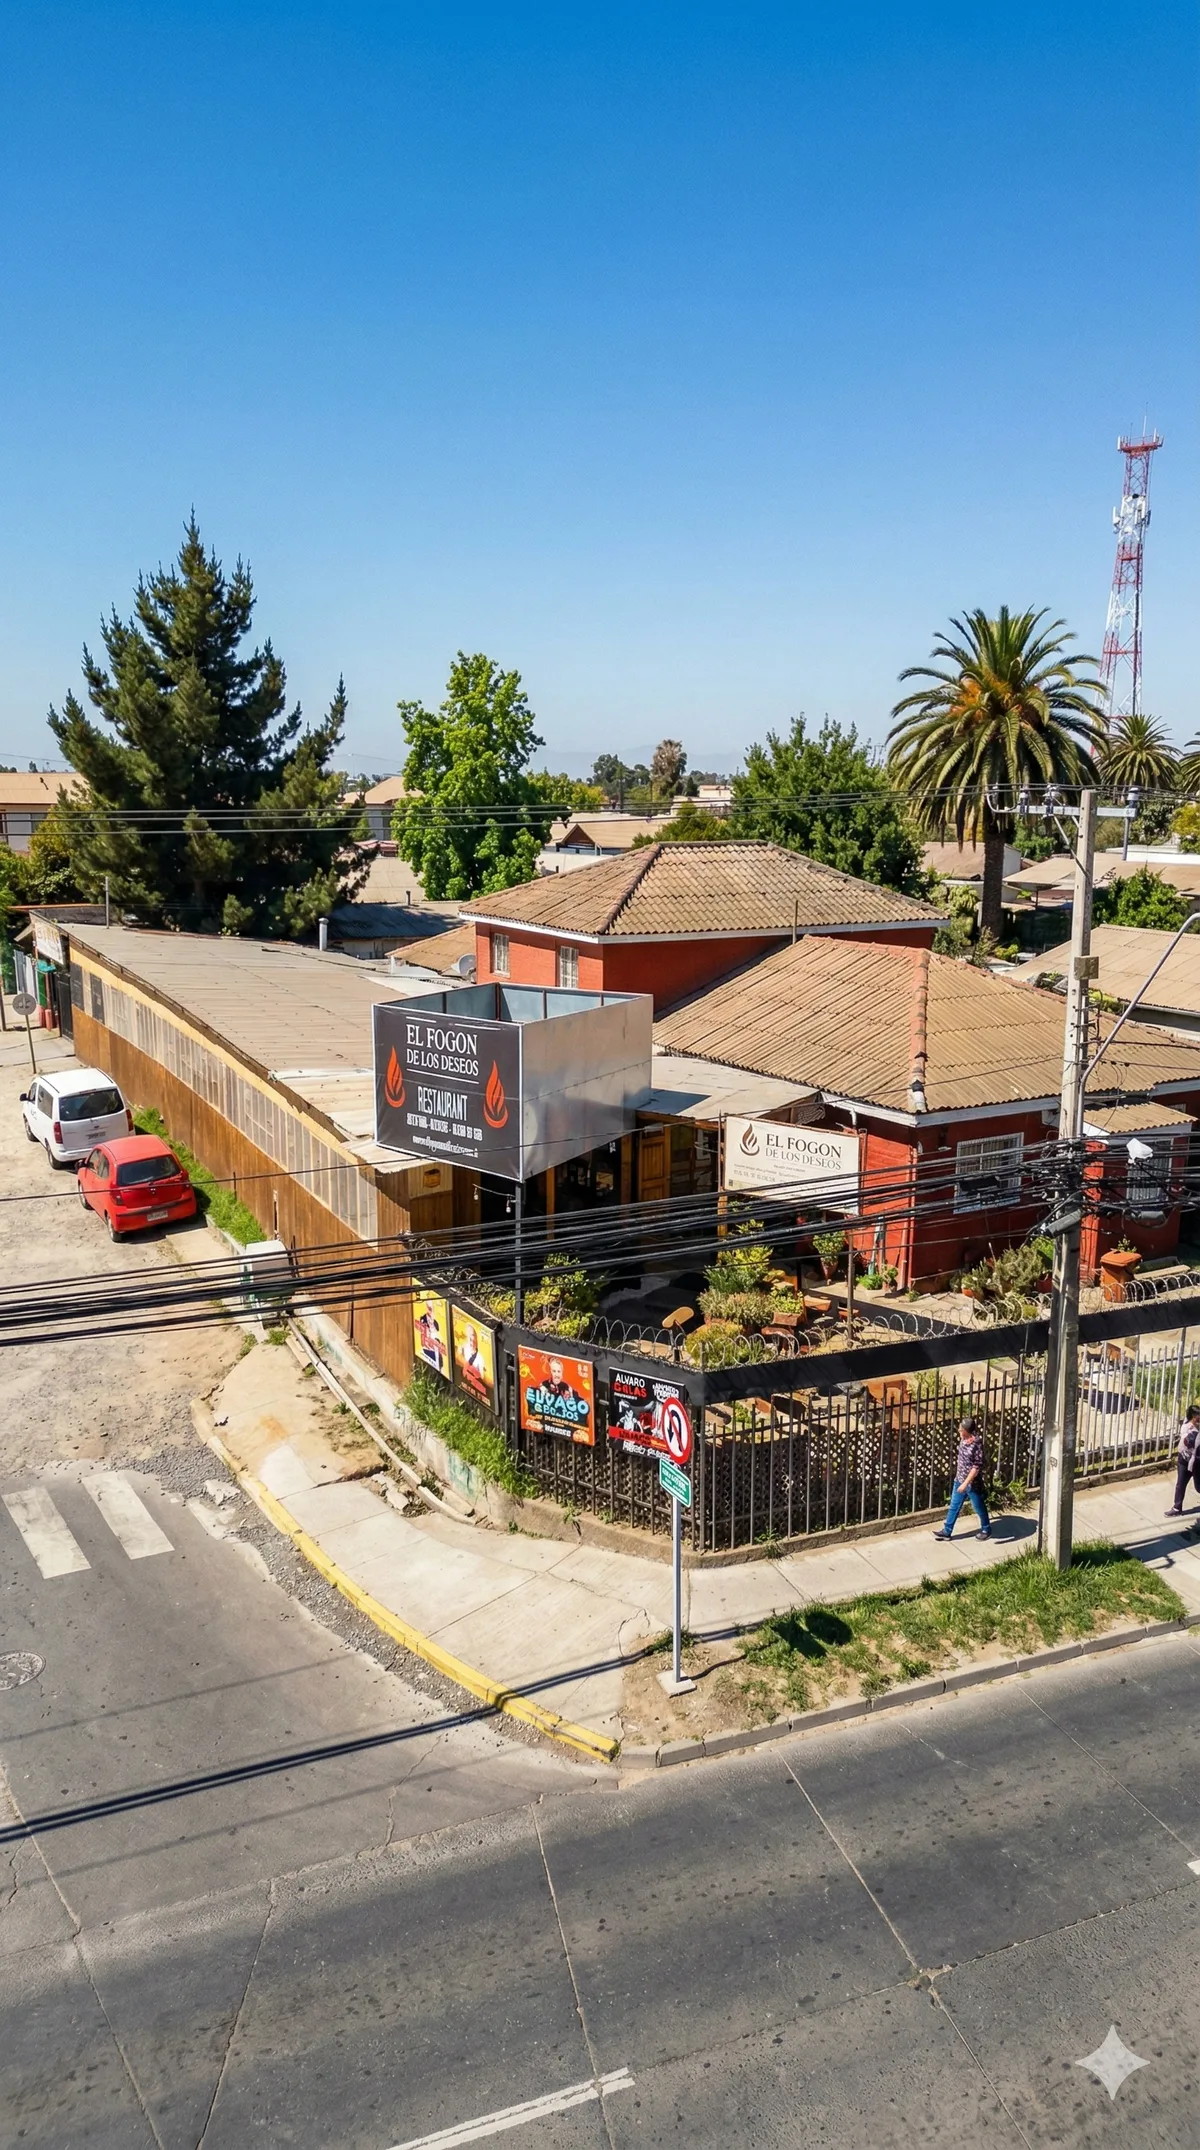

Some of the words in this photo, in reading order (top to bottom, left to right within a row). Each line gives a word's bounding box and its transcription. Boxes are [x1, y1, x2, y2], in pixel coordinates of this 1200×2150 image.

[406, 1024, 423, 1046] EL
[426, 1027, 478, 1055] FOGON
[406, 1049, 420, 1065] DE
[421, 1051, 439, 1069] LOS
[441, 1055, 479, 1076] DESEOS
[417, 1086, 468, 1121] RESTAURANT
[765, 1147, 779, 1158] DE
[781, 1149, 800, 1162] LOS
[802, 1154, 841, 1170] DESEOS
[766, 1133, 783, 1148] EL
[787, 1137, 841, 1158] FOGON
[615, 1373, 645, 1388] ALVARO
